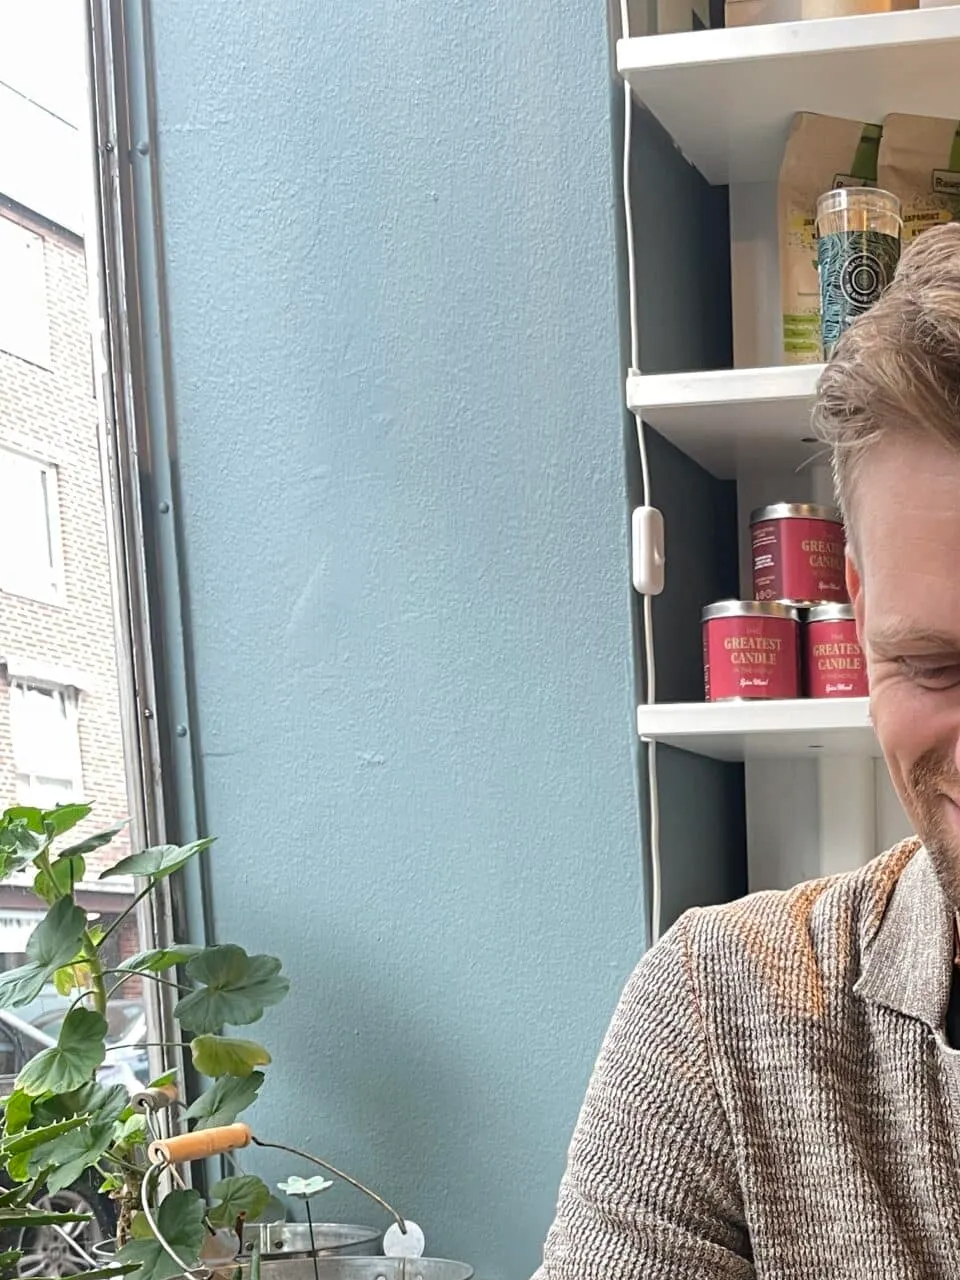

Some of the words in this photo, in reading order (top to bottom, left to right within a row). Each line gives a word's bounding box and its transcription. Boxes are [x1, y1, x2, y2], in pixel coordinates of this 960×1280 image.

[724, 636, 782, 651] GREATEST
[813, 643, 861, 656] GREATES
[731, 652, 776, 665] CANDLE
[818, 657, 861, 670] CANDLE
